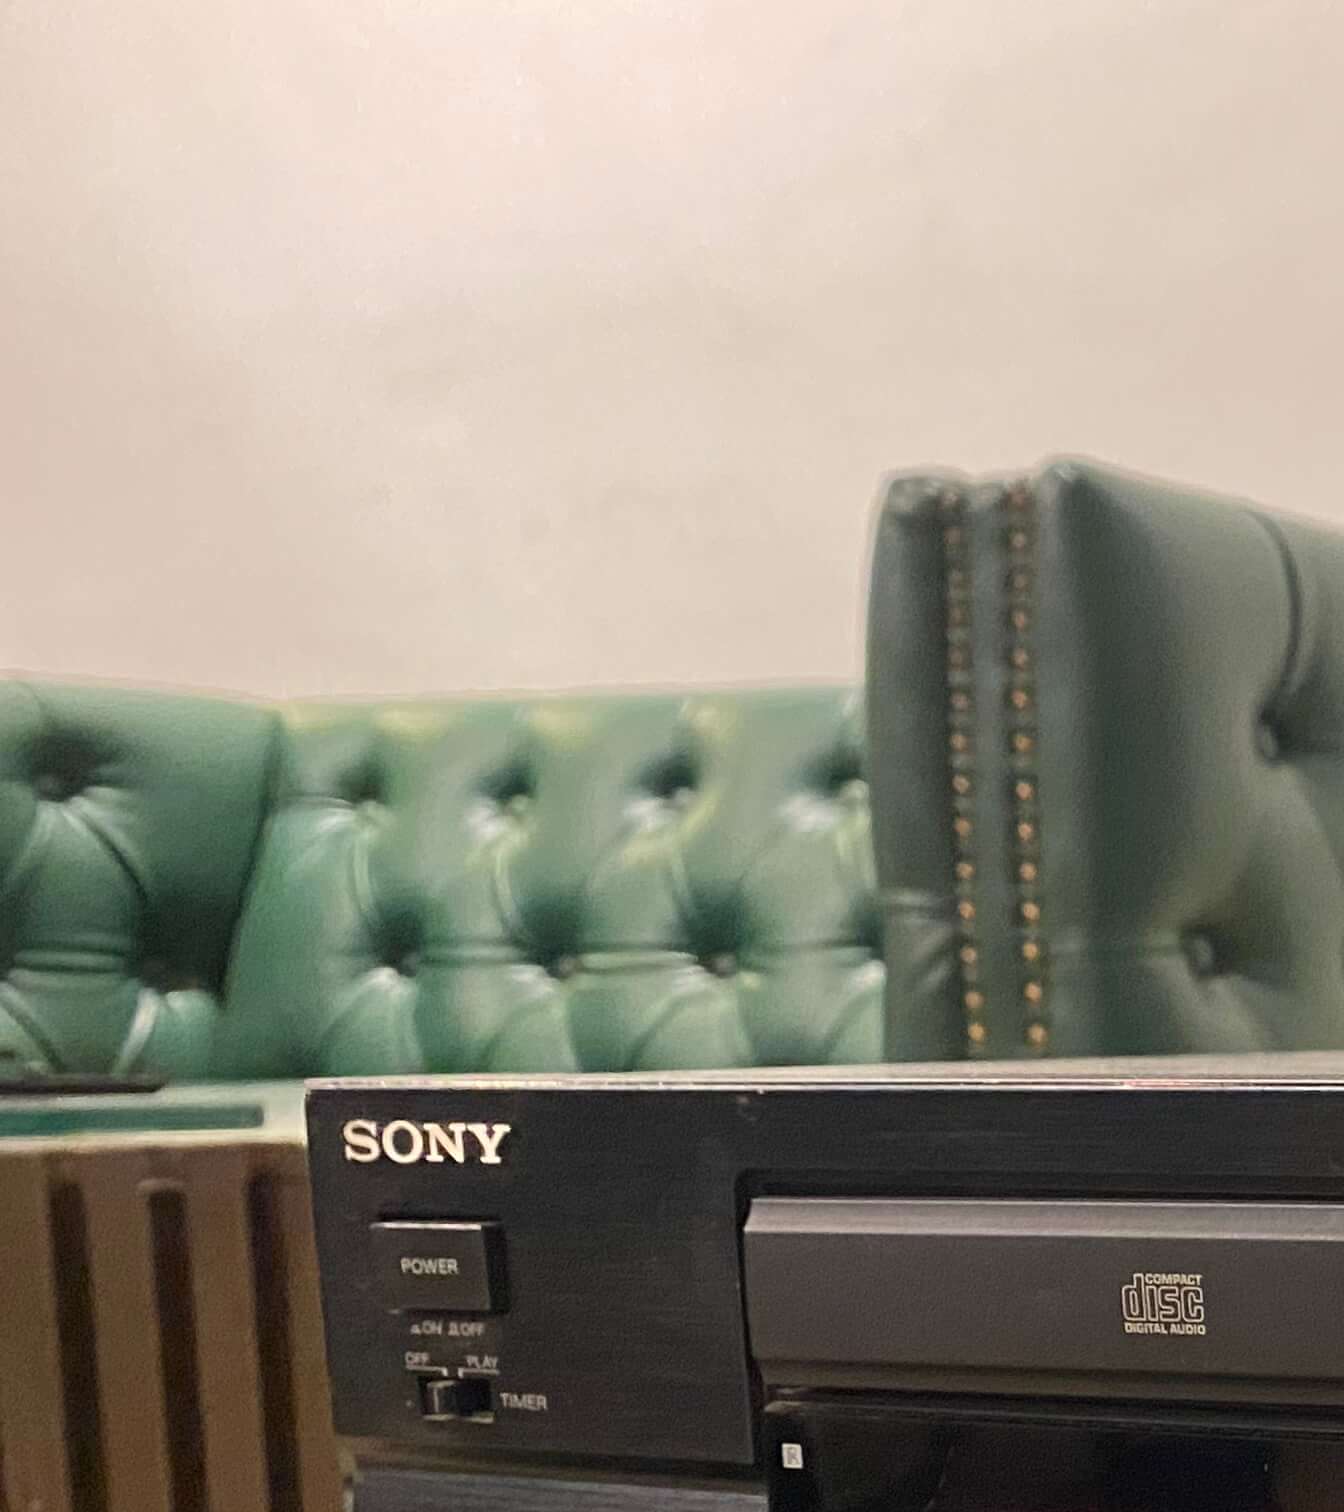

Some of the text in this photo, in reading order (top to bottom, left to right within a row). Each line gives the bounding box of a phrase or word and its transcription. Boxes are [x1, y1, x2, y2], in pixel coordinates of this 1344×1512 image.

[343, 1119, 511, 1165] SONY
[400, 1257, 459, 1276] POWER
[1145, 1273, 1202, 1285] COMPACT
[1125, 1323, 1206, 1335] DIGITAL AUDIO
[500, 1392, 547, 1410] TIMER
